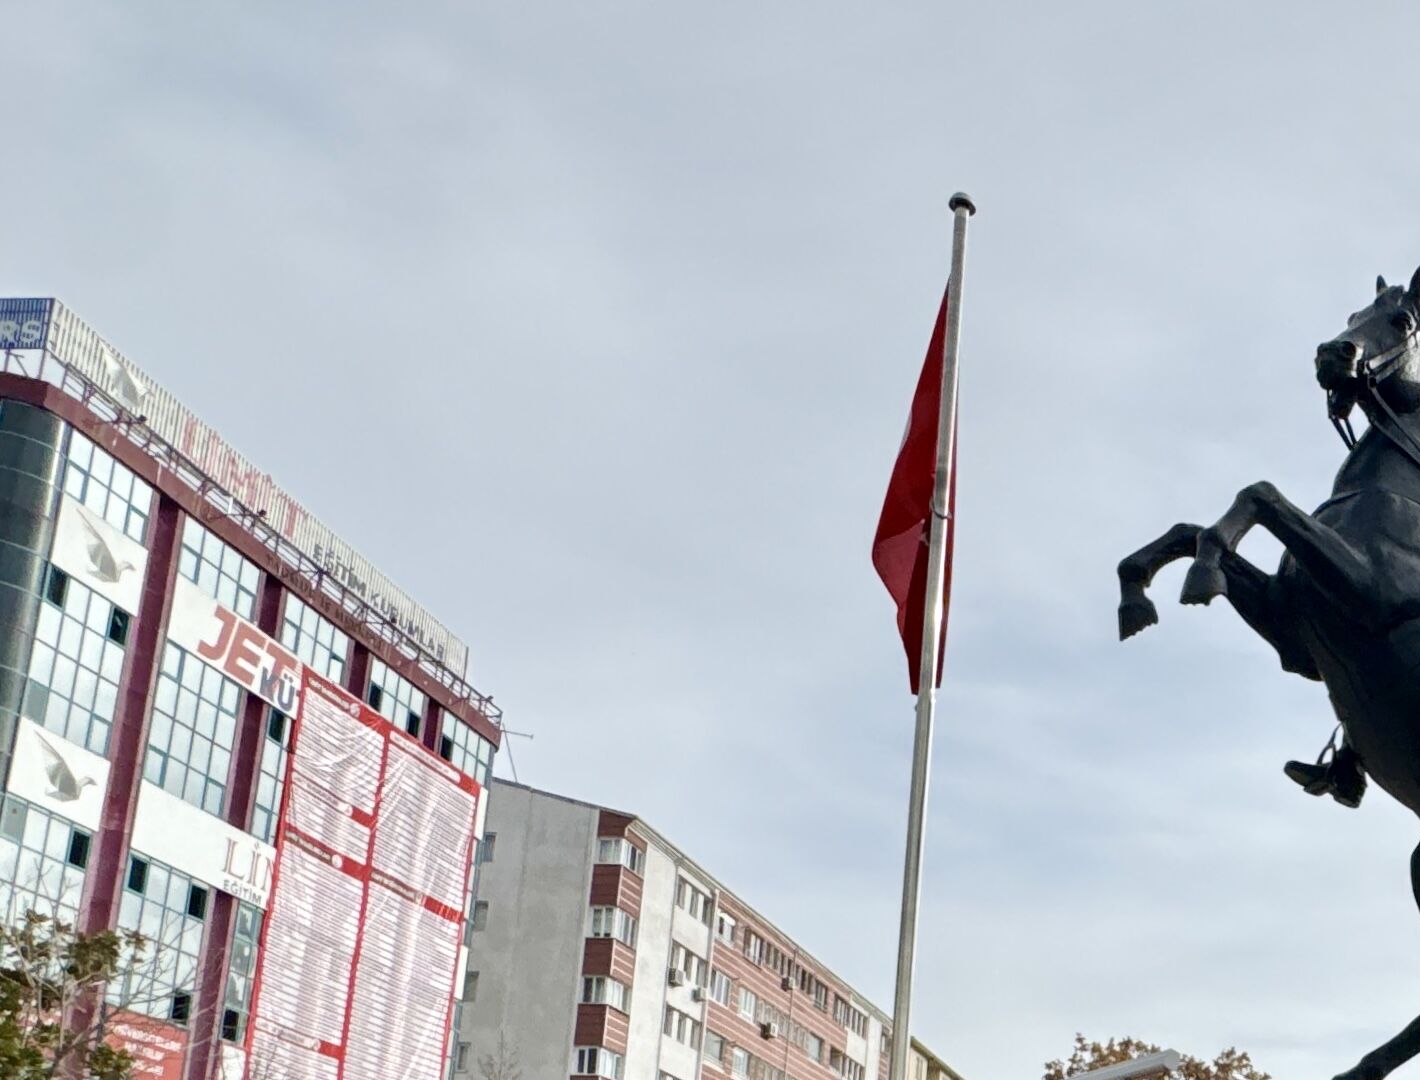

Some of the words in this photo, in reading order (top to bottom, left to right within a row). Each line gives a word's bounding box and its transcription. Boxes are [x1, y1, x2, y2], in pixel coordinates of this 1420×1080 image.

[197, 605, 299, 687] JET
[259, 665, 299, 712] KÜ
[222, 879, 262, 905] EĞİTİM
